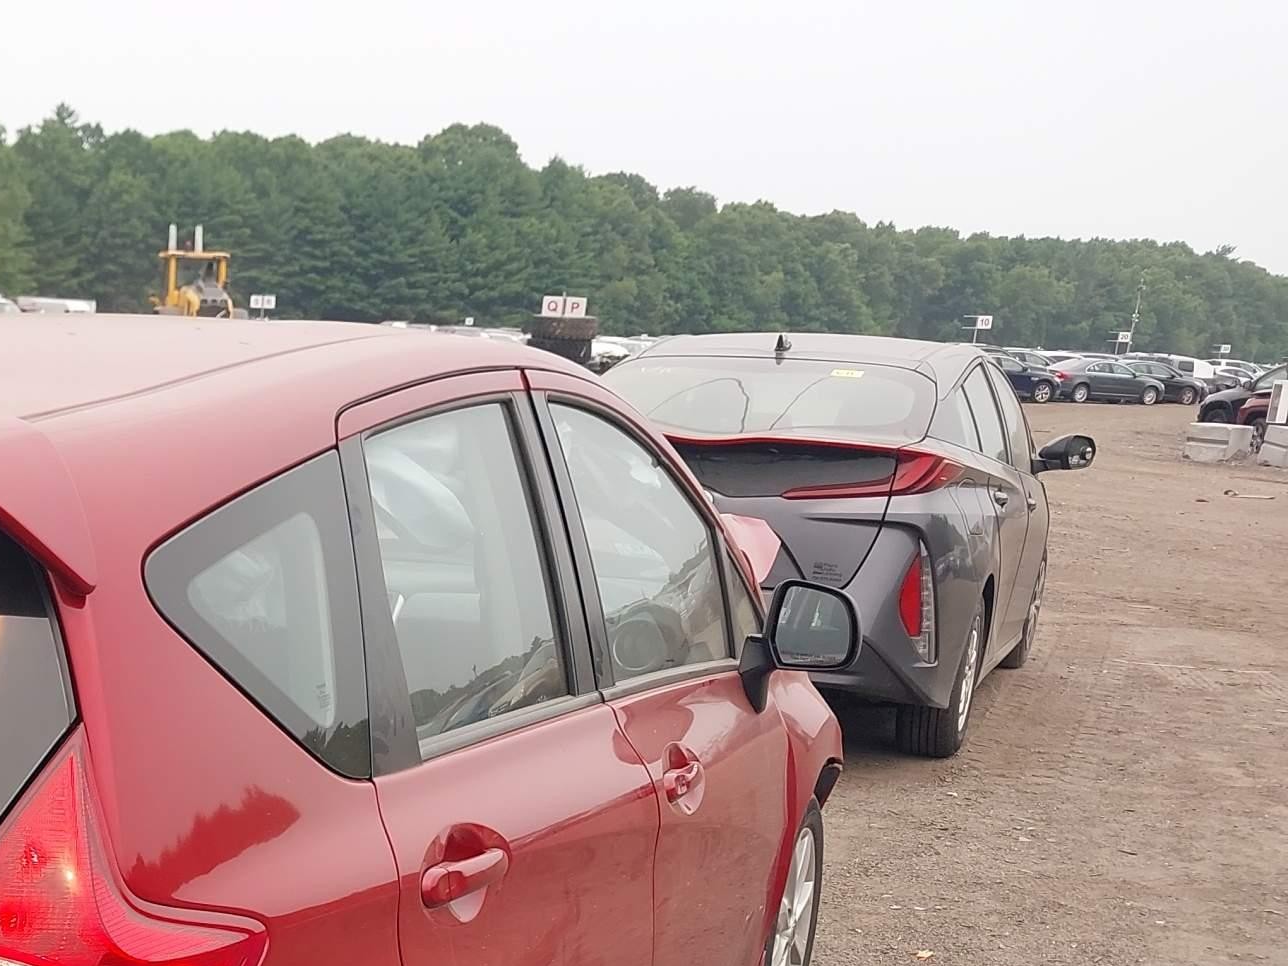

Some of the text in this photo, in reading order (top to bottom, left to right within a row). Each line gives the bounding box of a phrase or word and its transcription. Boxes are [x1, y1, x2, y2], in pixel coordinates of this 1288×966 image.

[547, 300, 559, 312] Q
[570, 302, 580, 313] P
[979, 318, 990, 327] 10
